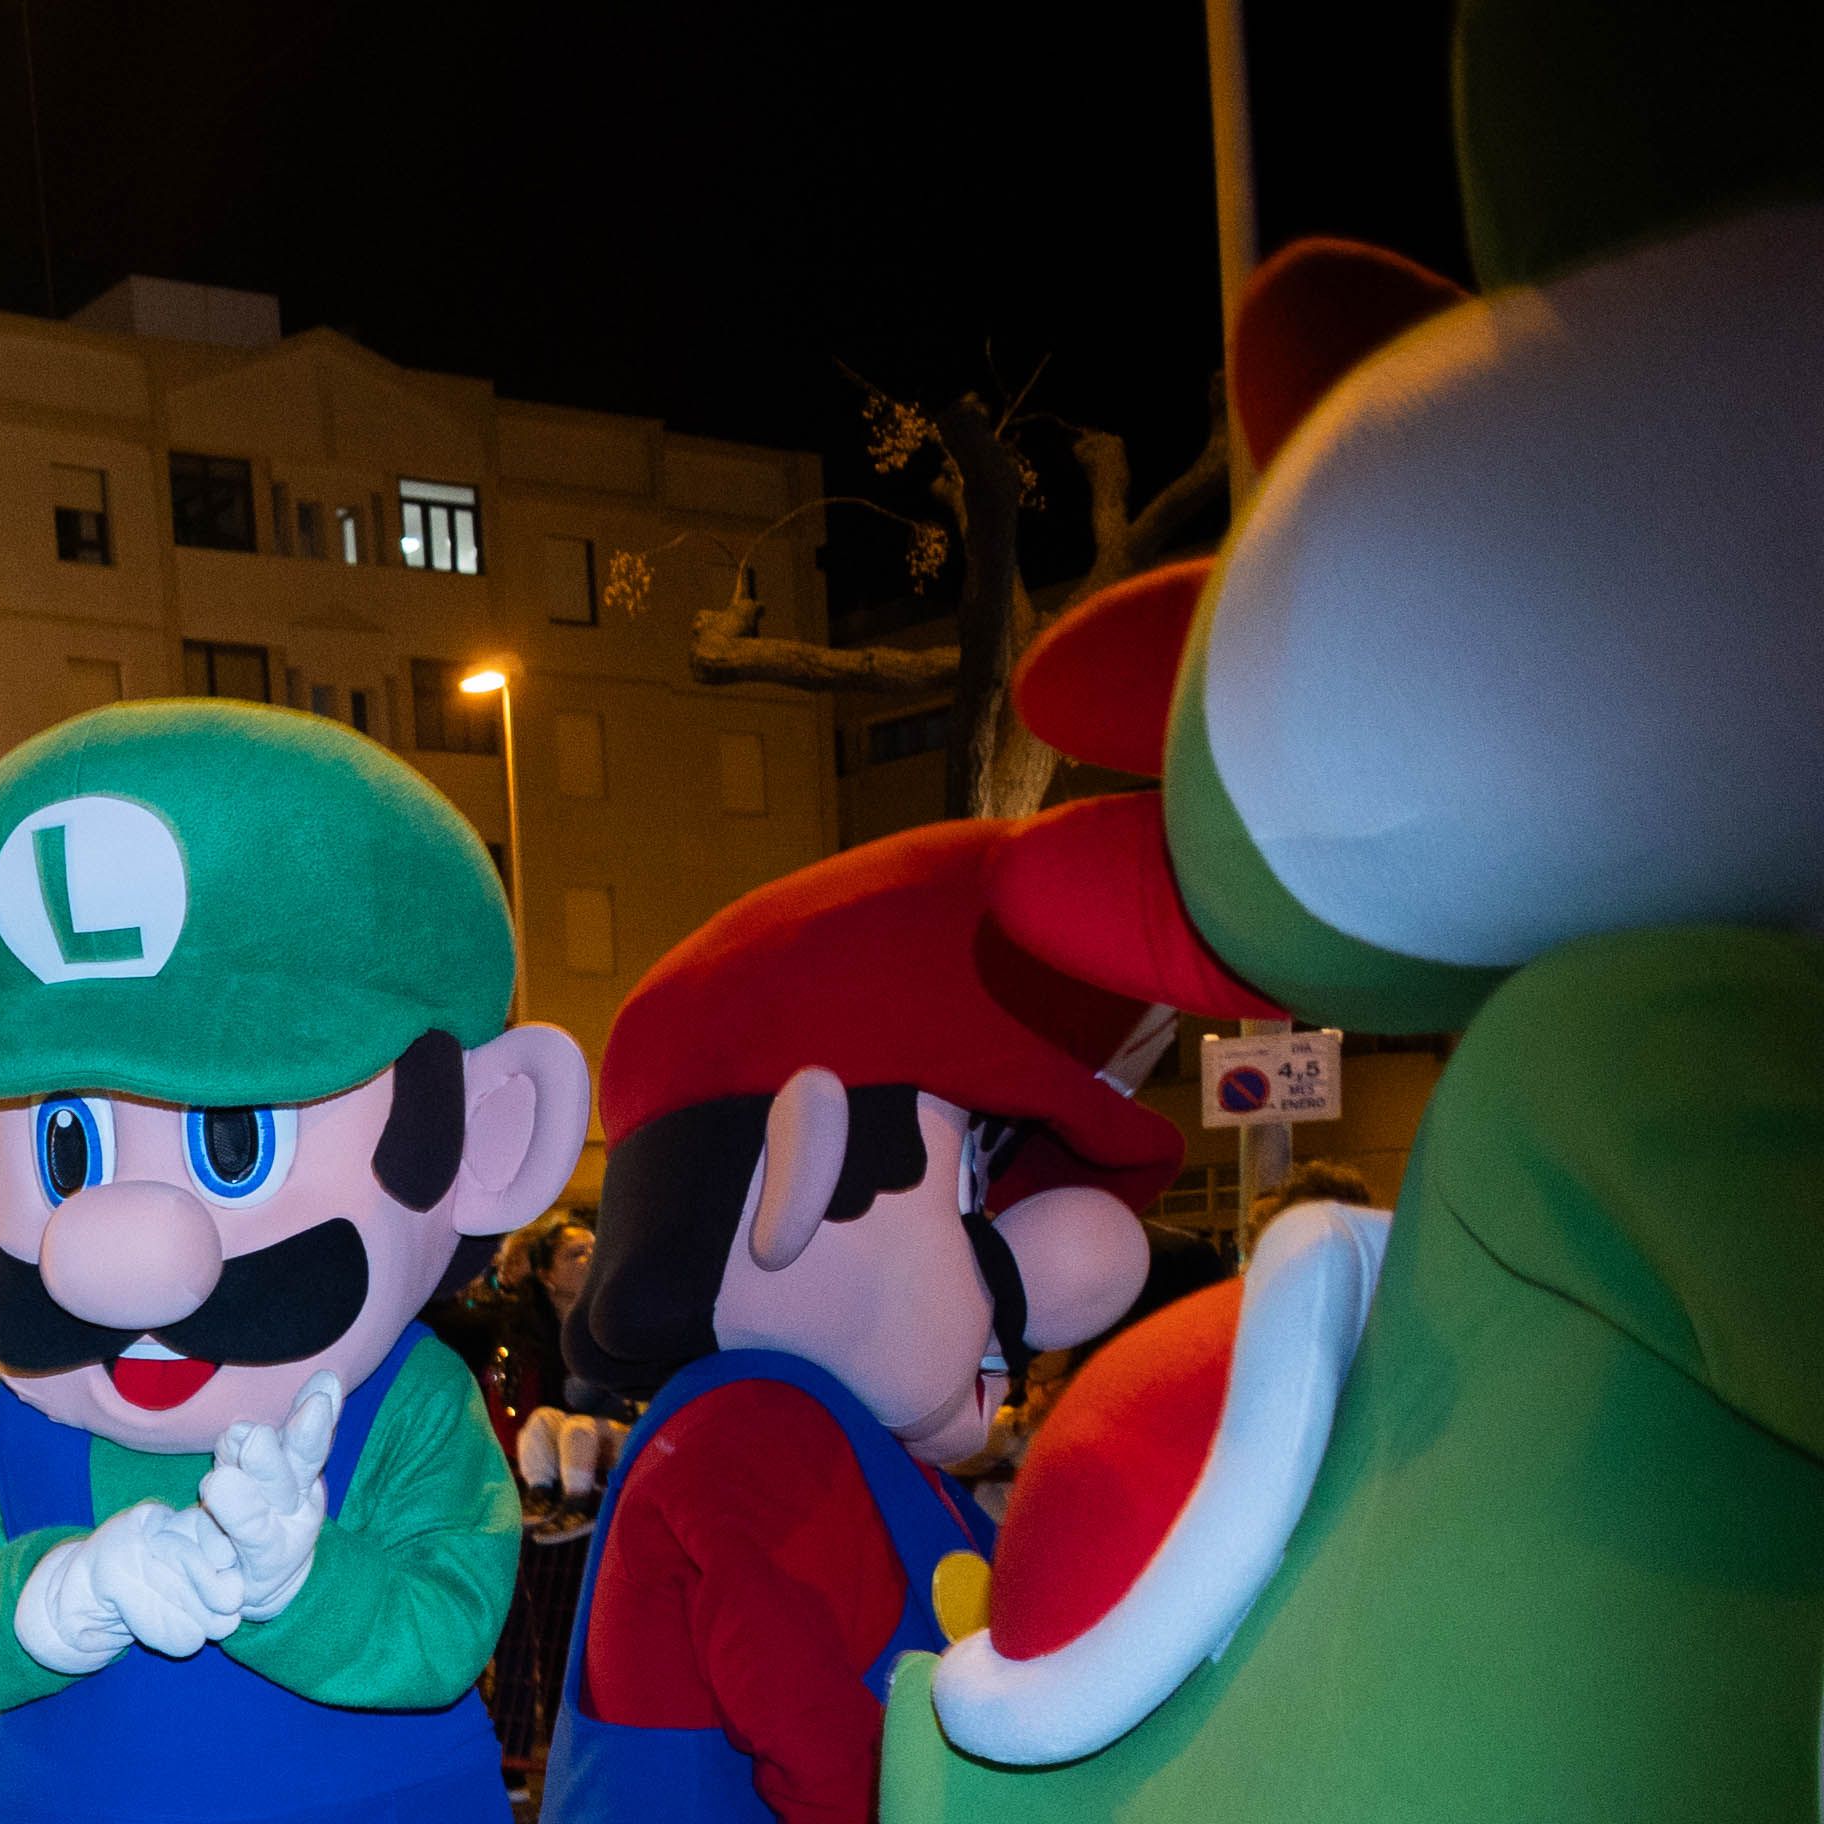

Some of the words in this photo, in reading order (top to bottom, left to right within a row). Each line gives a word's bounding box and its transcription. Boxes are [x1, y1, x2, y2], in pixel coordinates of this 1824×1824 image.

[31, 824, 145, 965] L
[1278, 1061, 1292, 1079] 4
[1306, 1060, 1321, 1077] 5
[1280, 1097, 1326, 1110] ENERO
